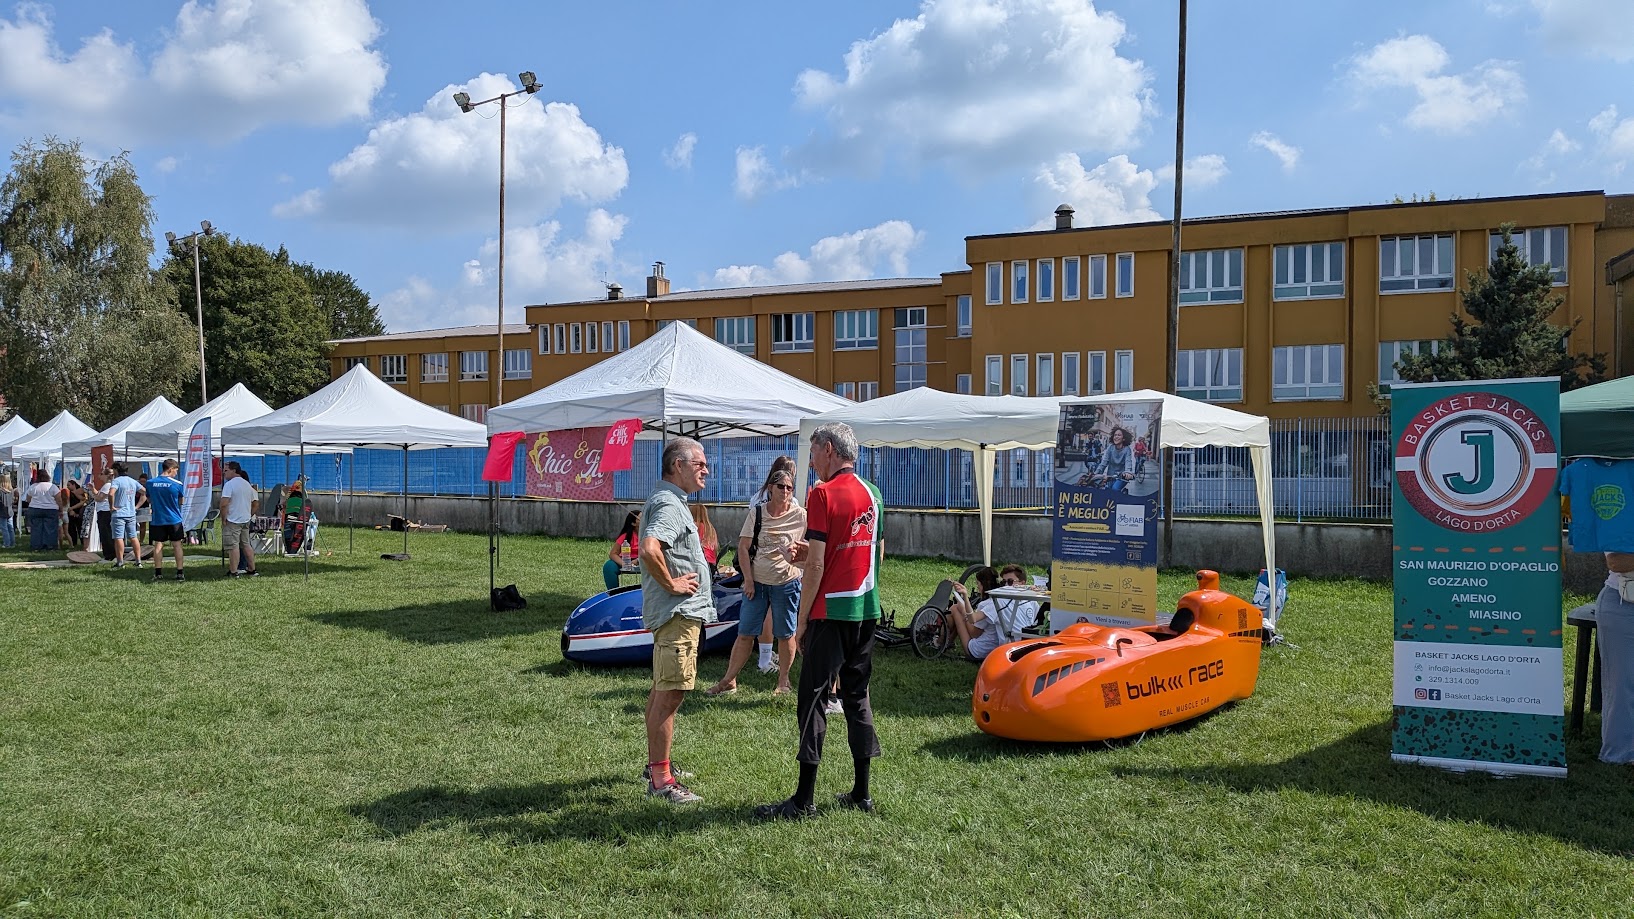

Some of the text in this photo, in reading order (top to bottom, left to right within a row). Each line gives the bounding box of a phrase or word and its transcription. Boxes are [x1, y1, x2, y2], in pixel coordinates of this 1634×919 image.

[1404, 396, 1546, 445] BASKET JACKS
[612, 427, 628, 437] CHIC
[535, 440, 605, 478] Chic & Fi
[1442, 429, 1495, 495] J
[1059, 492, 1093, 505] IN BICI
[1592, 493, 1624, 504] JACKS
[1058, 503, 1109, 520] È MEGLIO
[1435, 509, 1521, 531] LAGO D'ORTA
[1399, 560, 1559, 572] SAN MAURIZIO D'OPAGLIO
[1428, 577, 1488, 587] GOZZANO
[1451, 593, 1497, 604] AMENO
[1469, 610, 1522, 621] MIASINO
[1415, 651, 1541, 664] BASKET JACKS LAGO D'ORTA
[1428, 664, 1511, 676] info@jackslagodorta.it
[1126, 659, 1224, 701] bulk race
[1444, 692, 1541, 705] Basket Jacks Lago d'Orta
[1159, 696, 1210, 717] REAL MUSCLE CAR
